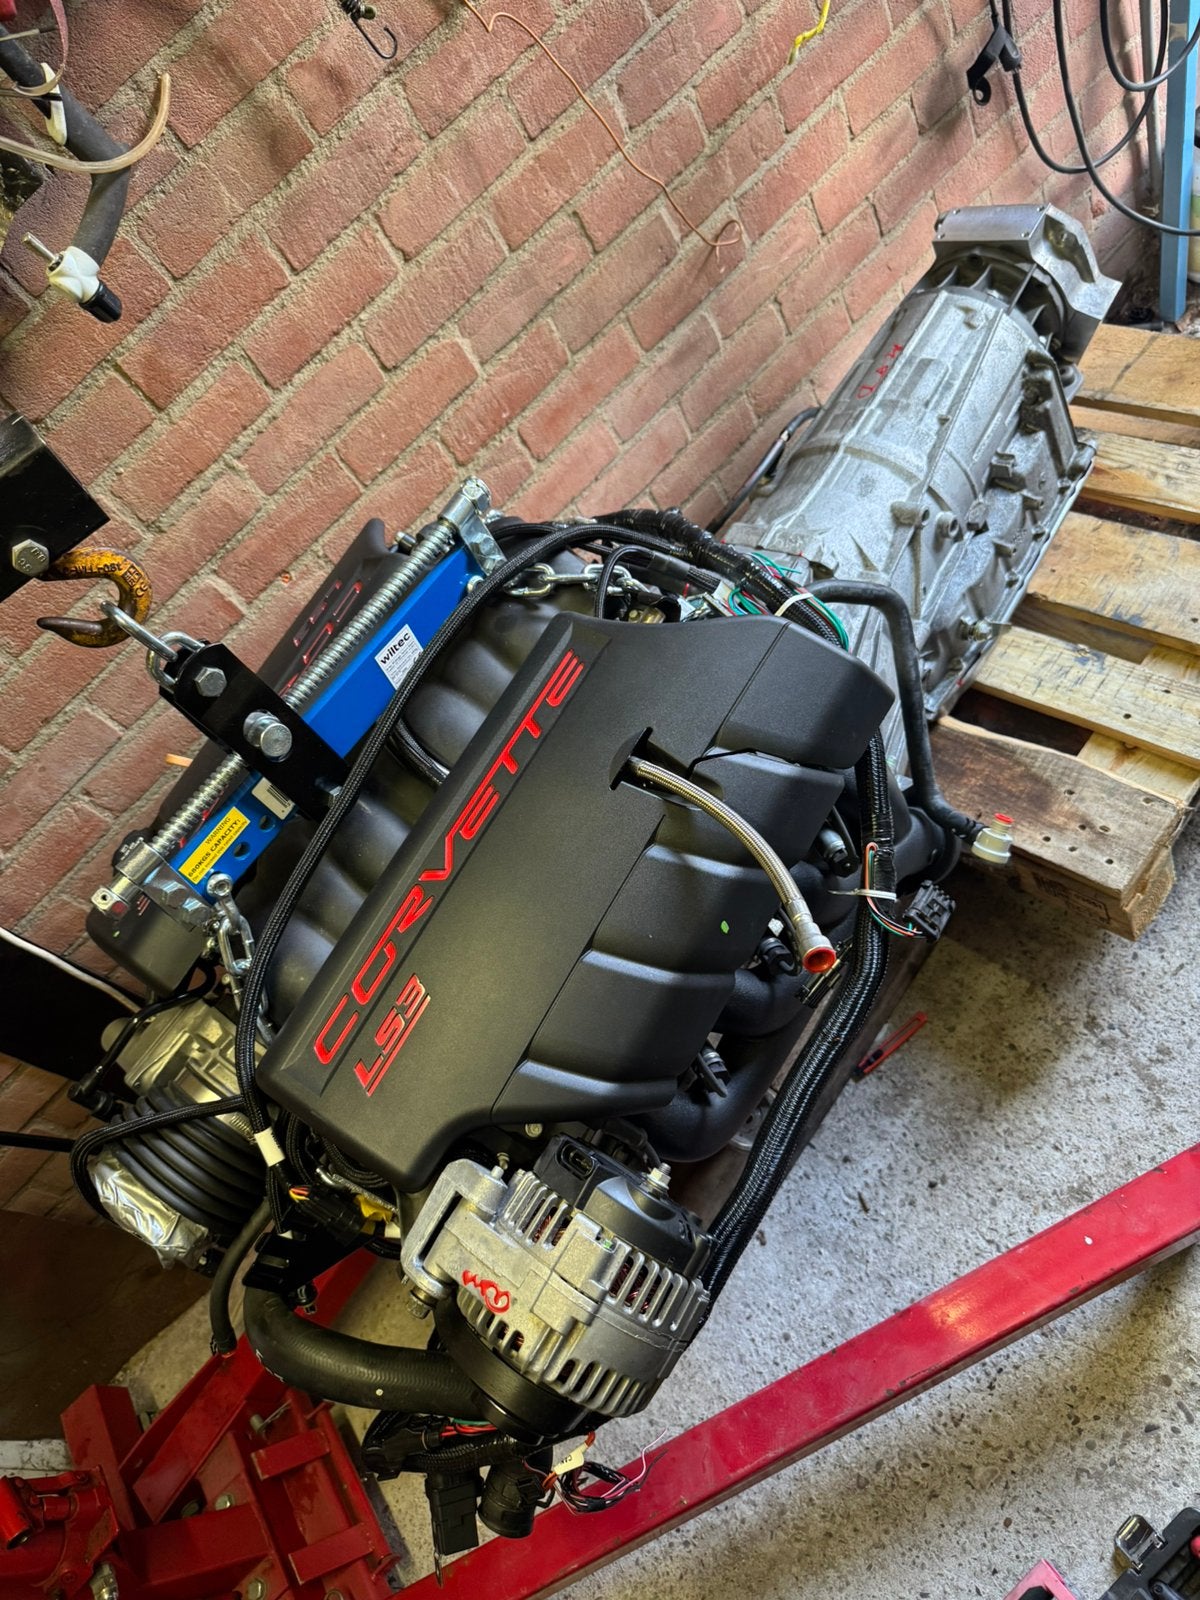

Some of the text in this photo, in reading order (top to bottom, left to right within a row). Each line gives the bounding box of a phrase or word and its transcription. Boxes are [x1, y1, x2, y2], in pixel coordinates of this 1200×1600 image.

[380, 632, 411, 665] wiltec
[205, 816, 231, 845] WARNING
[313, 648, 584, 1064] CORVETTE
[354, 973, 428, 1094] LS3
